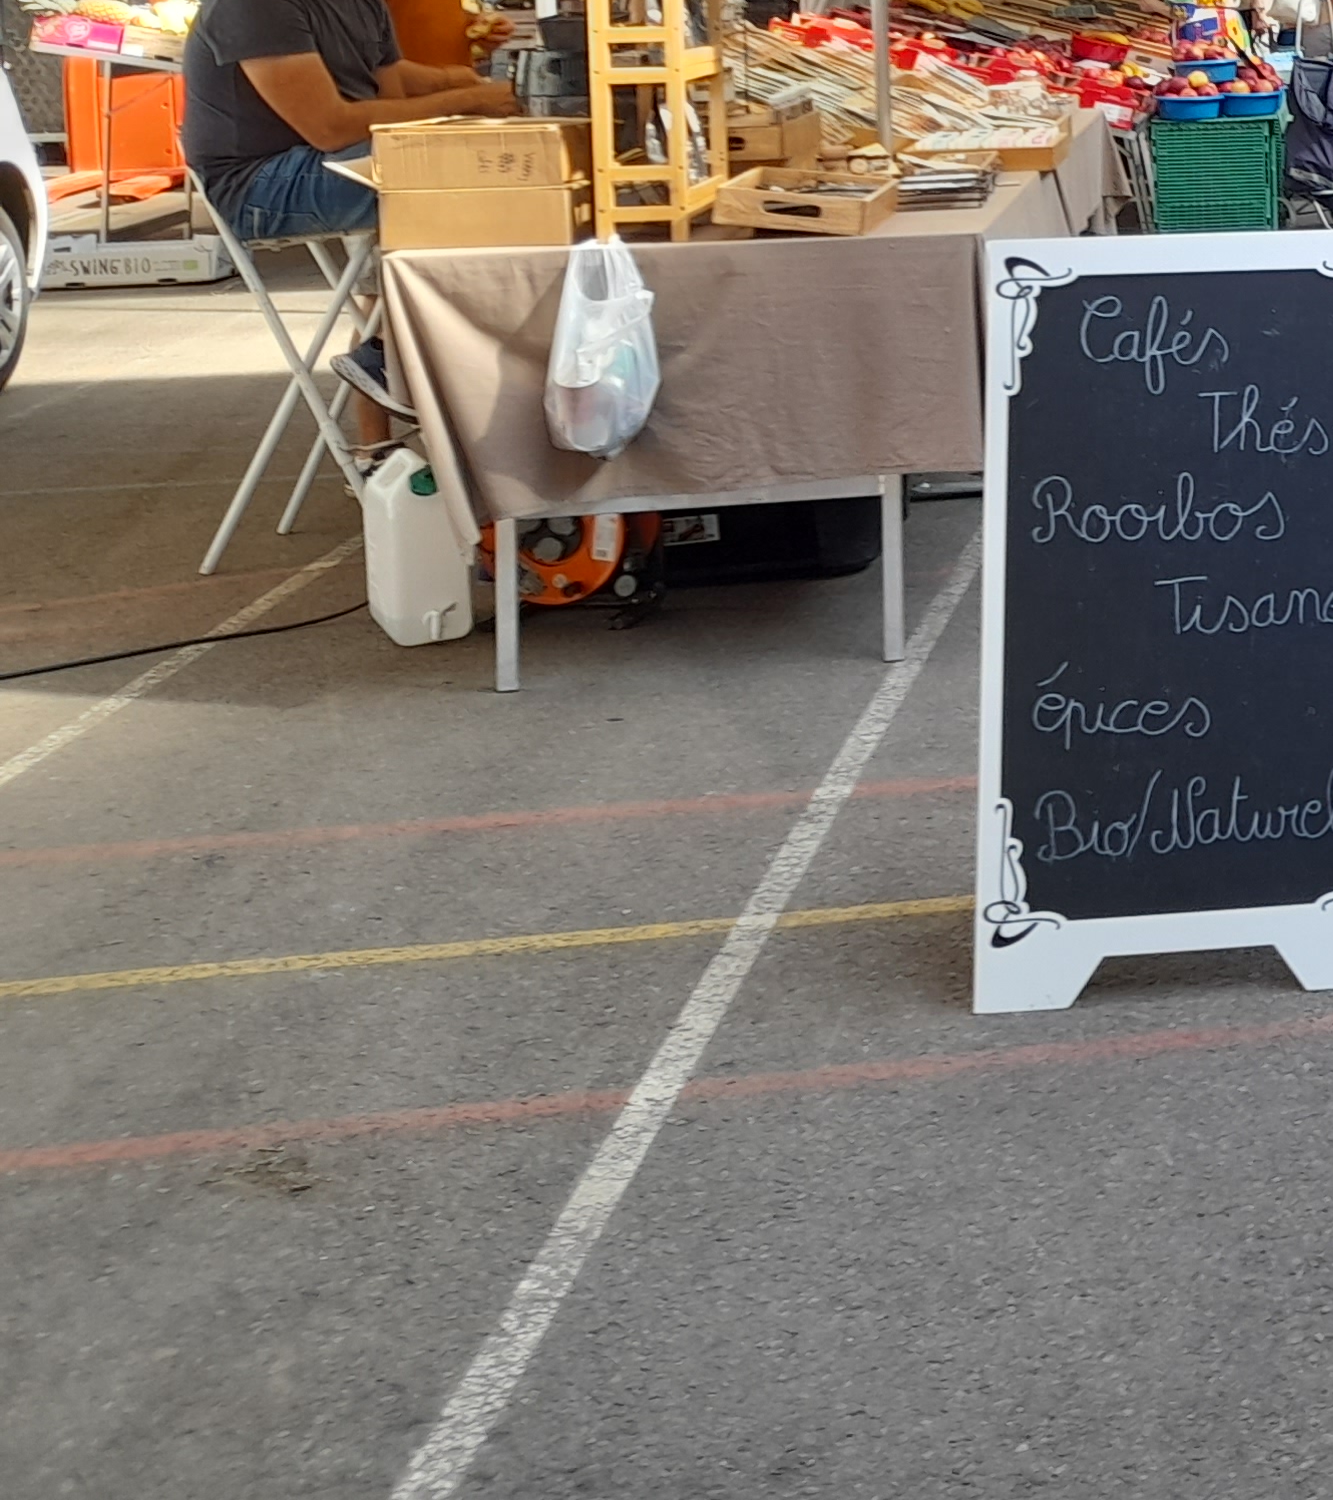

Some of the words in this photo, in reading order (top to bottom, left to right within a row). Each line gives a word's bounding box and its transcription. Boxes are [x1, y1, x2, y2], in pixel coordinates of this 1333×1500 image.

[70, 258, 122, 277] SWING
[1077, 296, 1229, 395] Cafés
[1198, 390, 1330, 457] Thés
[1031, 470, 1288, 543] Rooibos
[1033, 661, 1211, 748] épices
